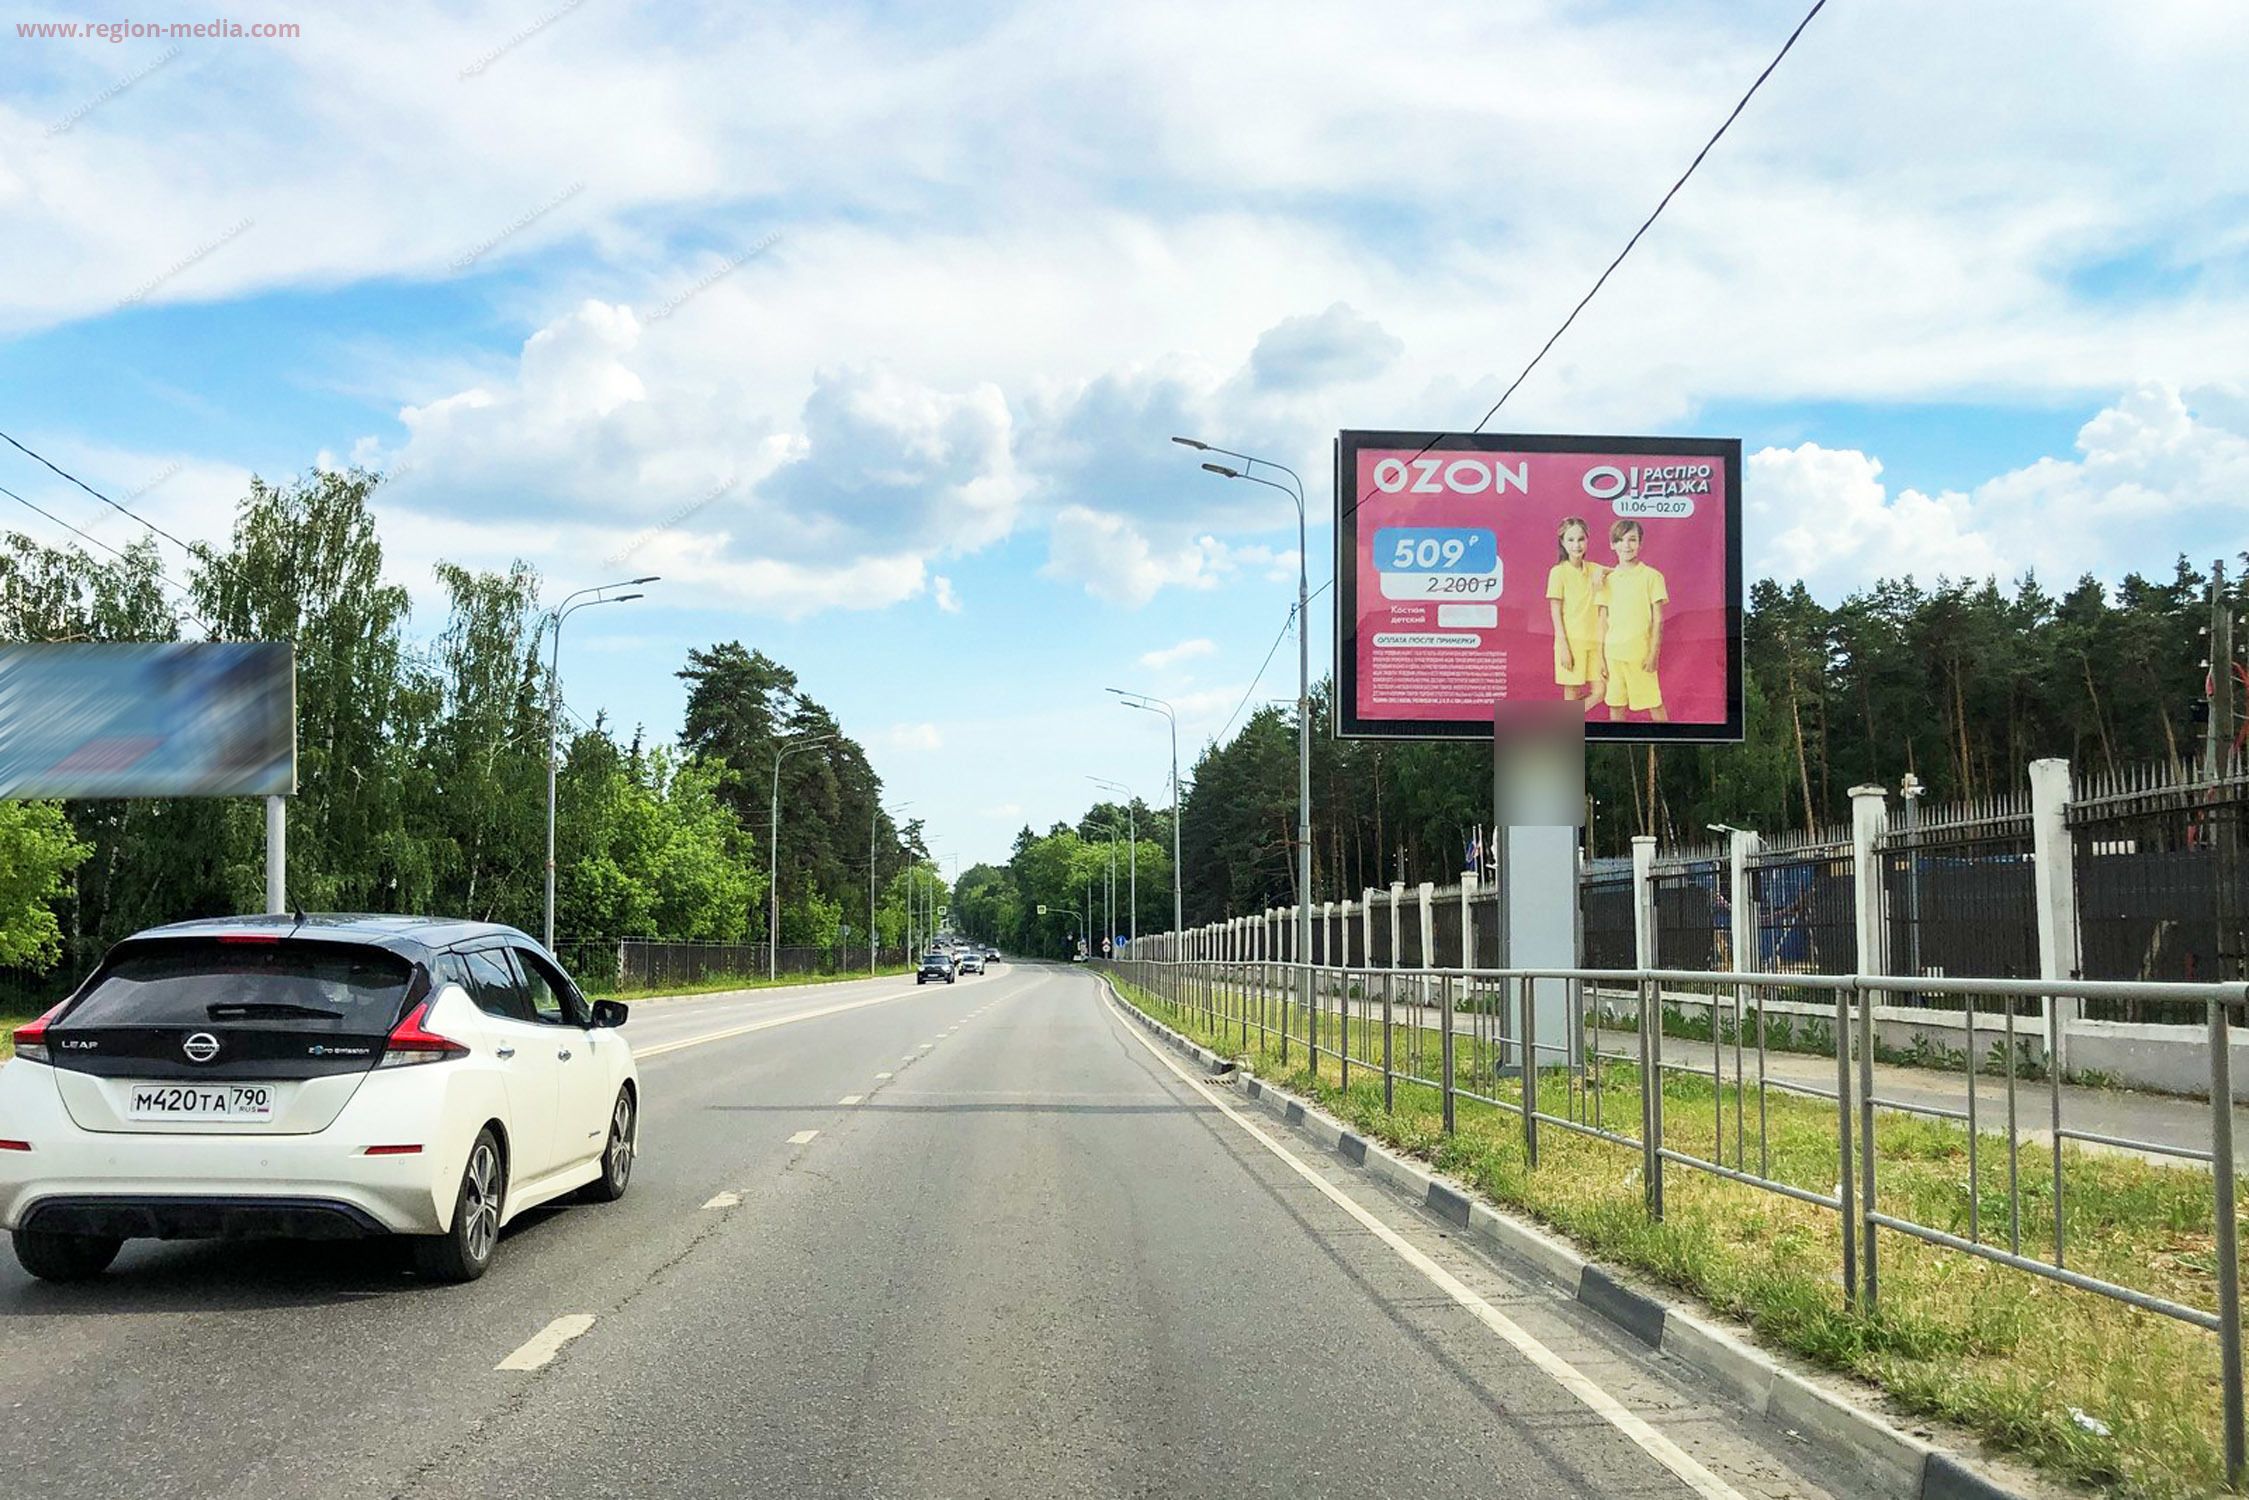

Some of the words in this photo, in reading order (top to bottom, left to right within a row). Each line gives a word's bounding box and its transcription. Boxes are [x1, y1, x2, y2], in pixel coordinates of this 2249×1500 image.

[1373, 458, 1528, 495] OZON
[1643, 464, 1712, 481] РАСПРО
[1641, 479, 1711, 499] ДАЖА
[1393, 538, 1464, 569] 509
[1391, 605, 1425, 614] Костюм
[1391, 615, 1426, 624] детский
[1377, 636, 1407, 644] ОПЛАТА
[233, 1089, 267, 1106] 790
